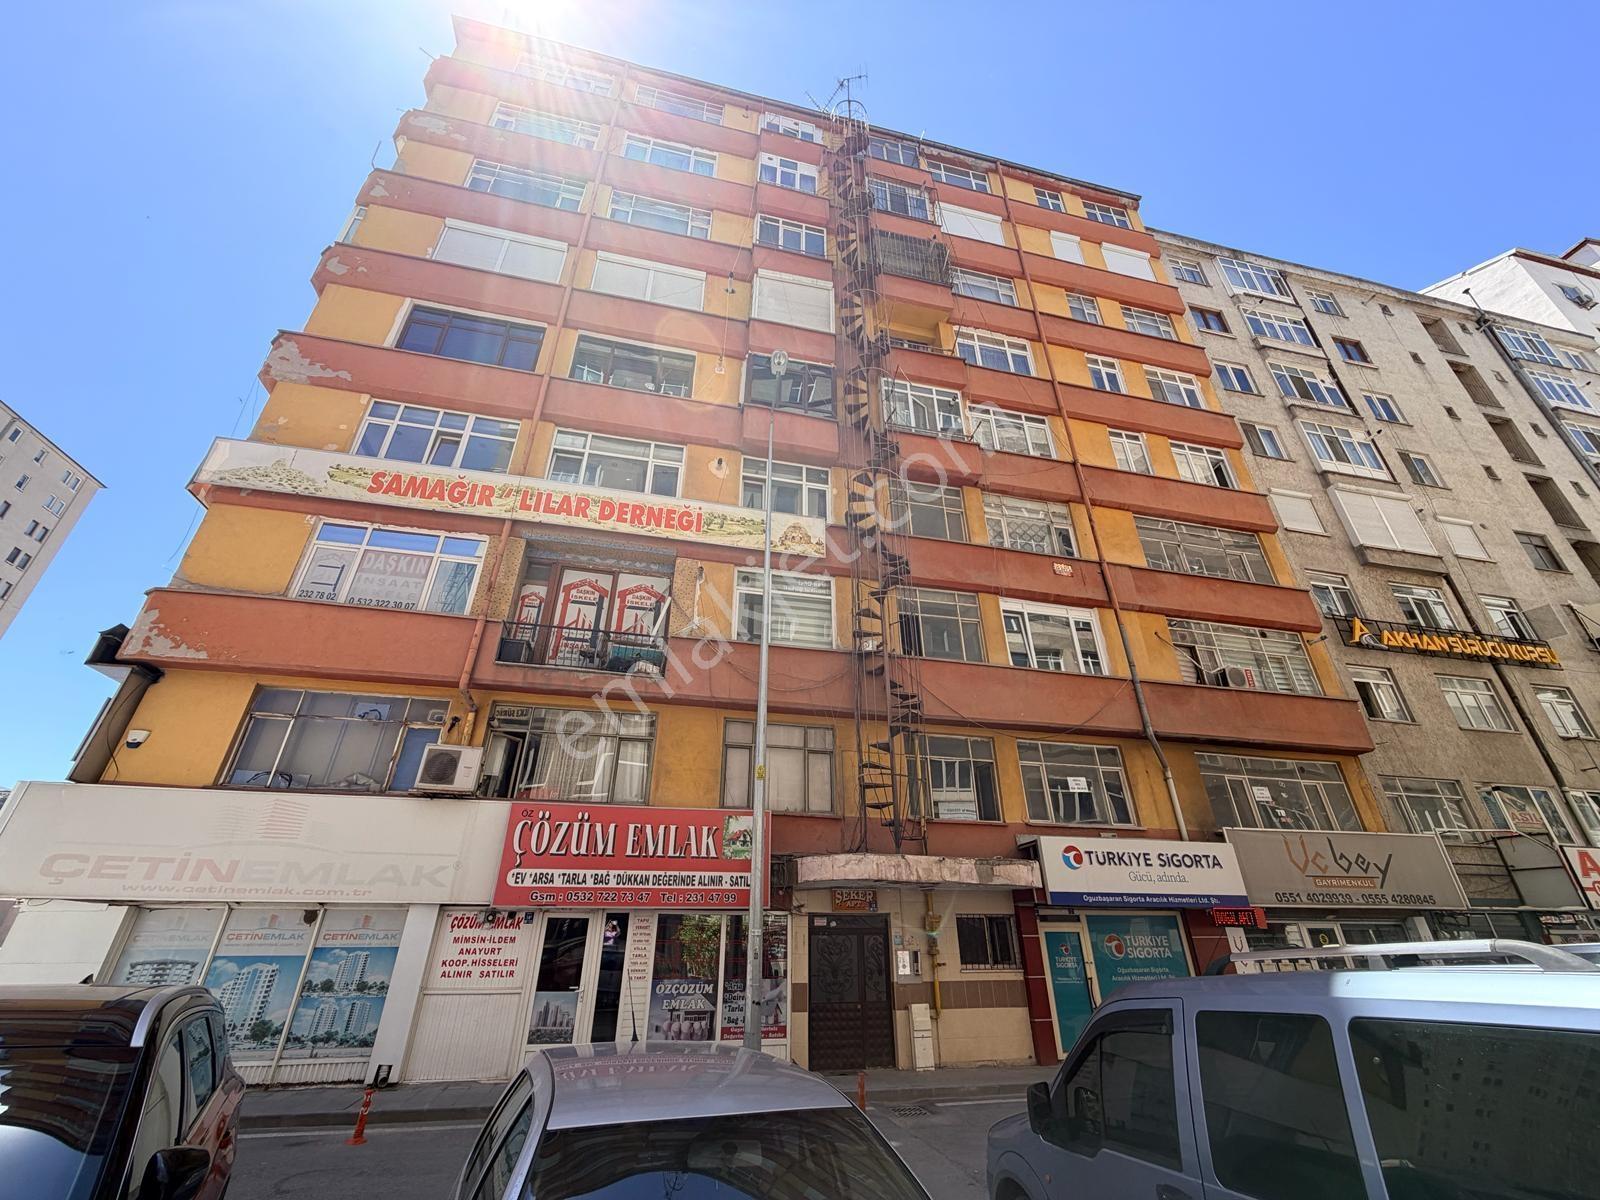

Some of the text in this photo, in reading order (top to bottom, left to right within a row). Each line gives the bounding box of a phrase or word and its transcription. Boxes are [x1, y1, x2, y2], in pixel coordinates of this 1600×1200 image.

[599, 500, 703, 533] DERNEĞİ
[362, 552, 429, 575] DAŞKIN
[1382, 630, 1559, 664] AKHAN SÜRÜCÜ KURSU
[513, 810, 720, 867] ÇÖZÜM EMLAK
[1084, 850, 1224, 870] TÜRKİYE SİGORTA
[652, 872, 696, 887] DEĞERİNDE
[697, 875, 723, 888] ALINIR
[566, 891, 594, 902] 0532
[597, 892, 617, 902] 722
[621, 892, 634, 902] 73
[637, 892, 650, 902] 47
[660, 893, 677, 903] Tel
[686, 893, 704, 903] 231
[708, 893, 721, 903] 47
[724, 893, 737, 903] 99
[1275, 892, 1303, 903] 0551
[1306, 892, 1353, 904] 4029939
[1361, 893, 1389, 904] 0555
[1391, 894, 1437, 905] 4280845
[492, 916, 524, 930] MLAK
[458, 947, 502, 956] ANAYURT
[440, 970, 515, 978] ALINIR SATILIR
[662, 999, 706, 1010] EMLAK
